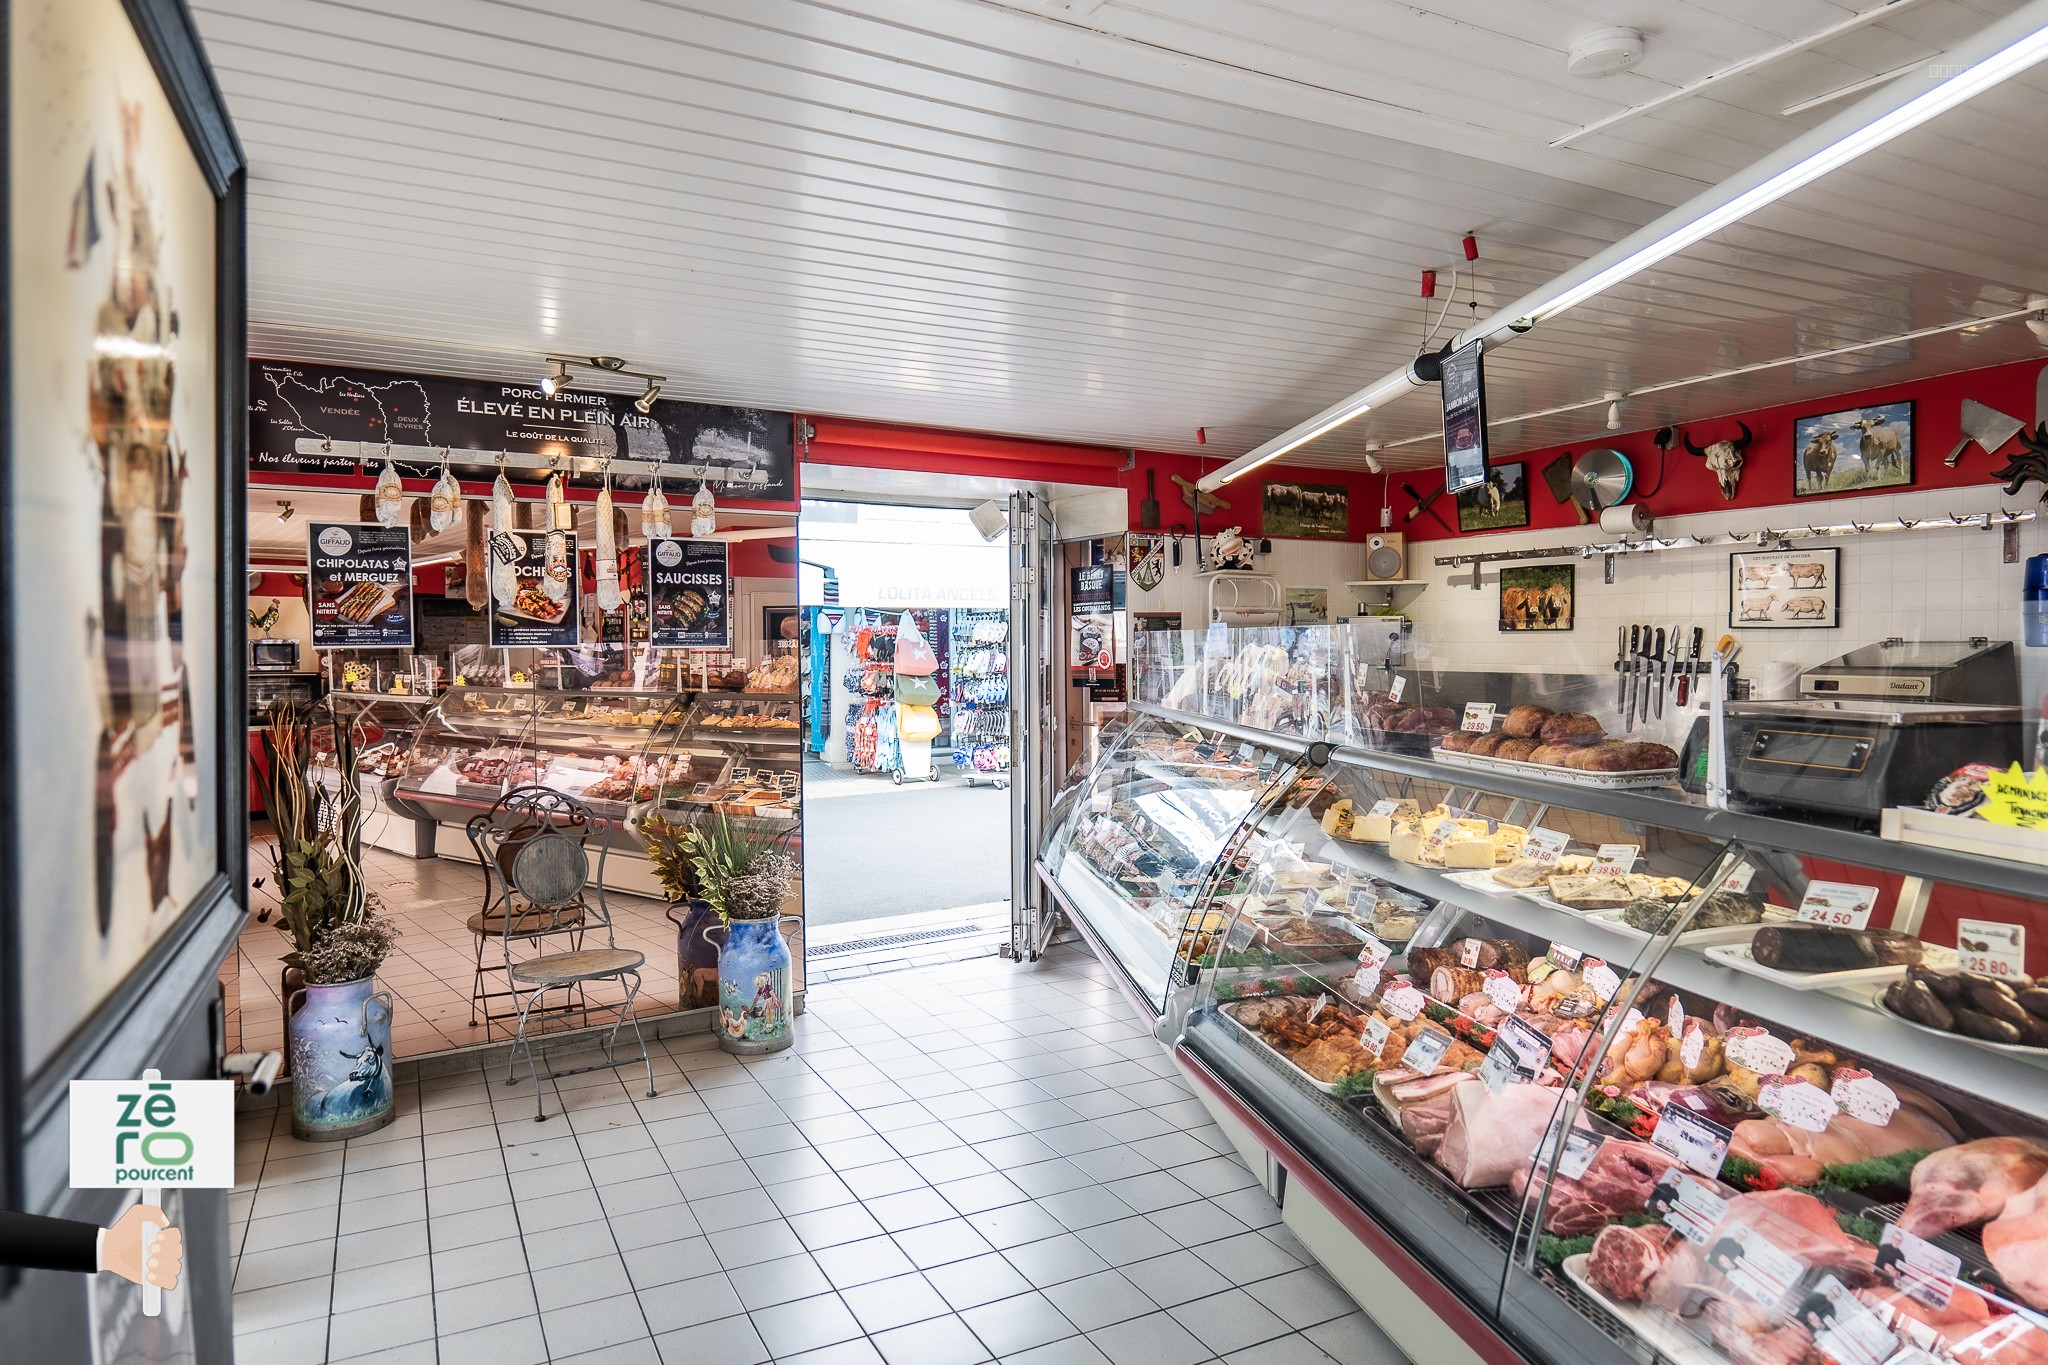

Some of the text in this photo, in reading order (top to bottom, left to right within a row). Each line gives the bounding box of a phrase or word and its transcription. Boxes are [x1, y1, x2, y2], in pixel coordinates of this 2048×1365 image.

[502, 387, 607, 406] PORC FERMIER
[320, 406, 360, 416] VENDÉE
[457, 396, 650, 429] ÉLEVÉ EN PLEIN AIR
[506, 430, 518, 438] LE
[520, 431, 543, 440] GOÛT
[571, 435, 606, 445] QUALITÉ
[259, 452, 279, 463] Nos
[281, 452, 320, 467] éleveurs
[316, 558, 390, 569] CHIPOLATAS
[329, 572, 399, 582] et MERGUEZ
[656, 572, 722, 585] SAUCISSES
[1079, 572, 1086, 581] LE
[1080, 580, 1103, 591] BASQUE
[878, 586, 997, 601] LOLITA ANGELS
[1890, 682, 1919, 690] Dadaux
[1529, 848, 1552, 861] 38.50
[1597, 865, 1622, 875] 39.50
[1810, 909, 1852, 925] 24.50
